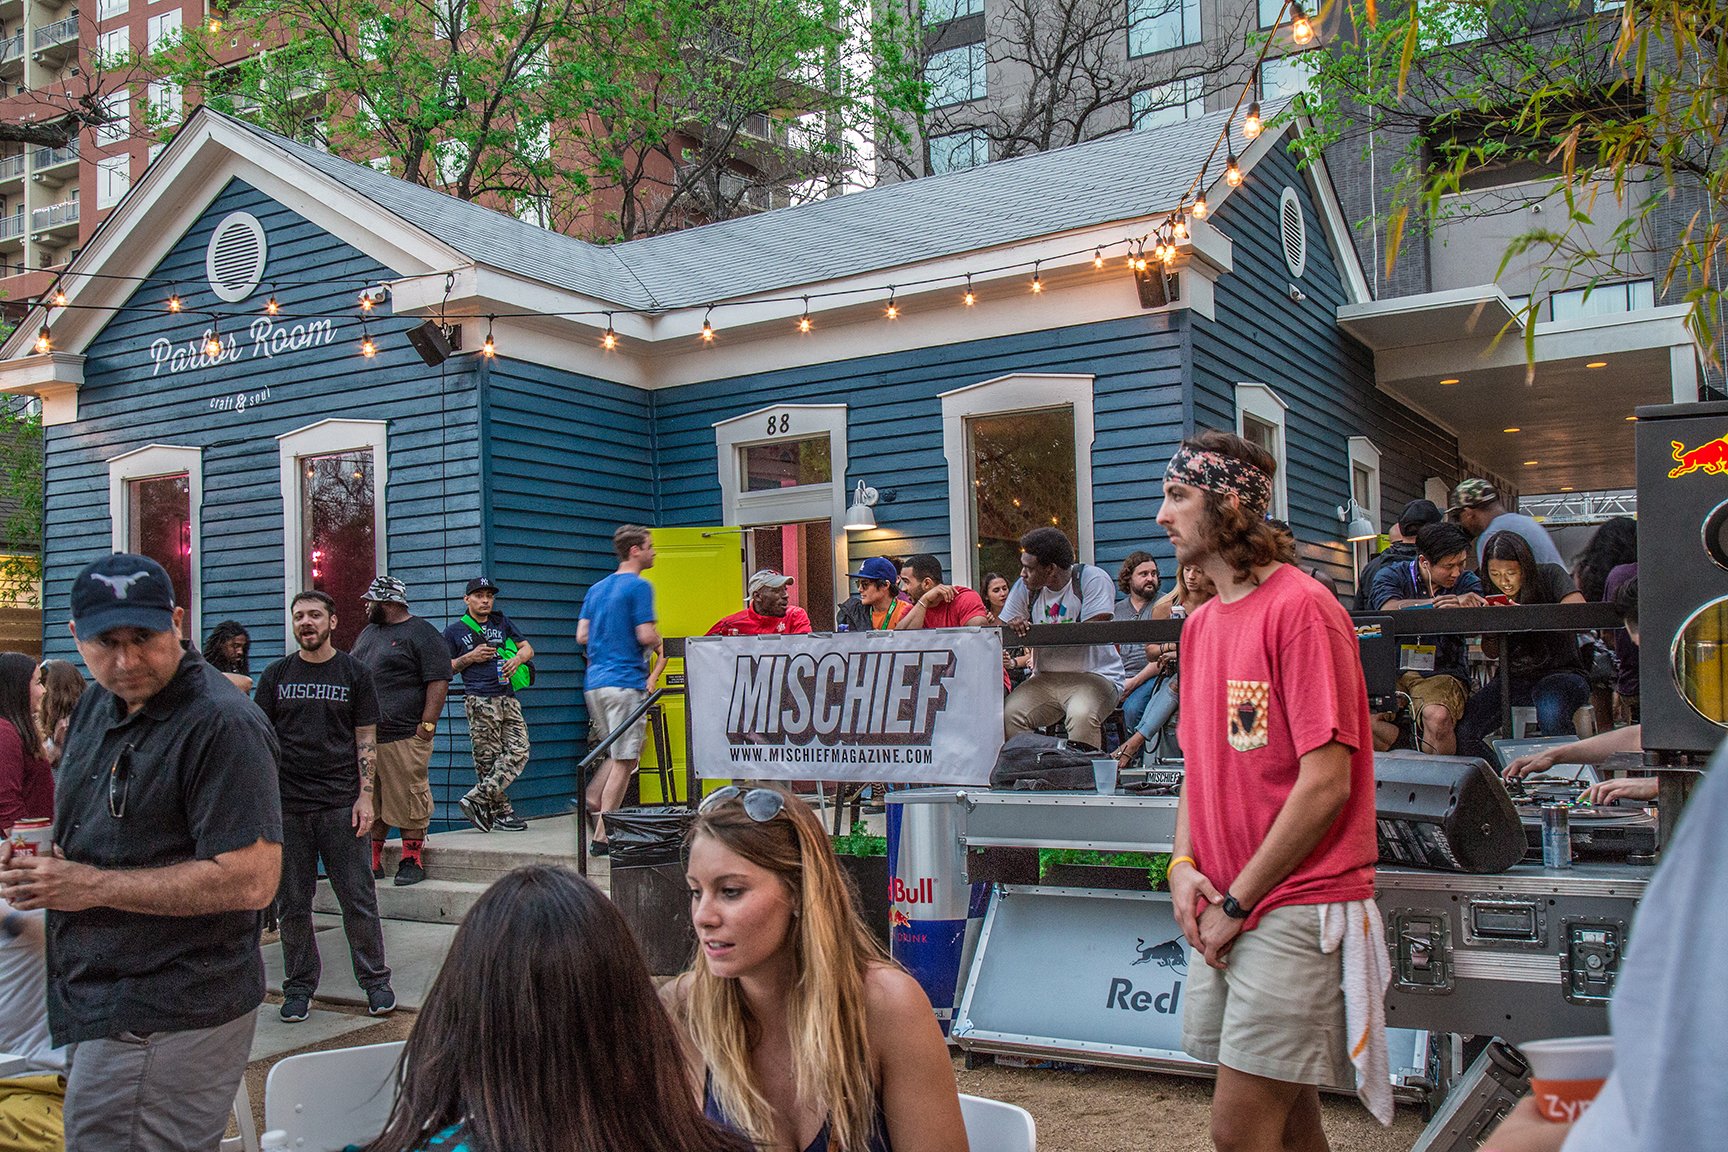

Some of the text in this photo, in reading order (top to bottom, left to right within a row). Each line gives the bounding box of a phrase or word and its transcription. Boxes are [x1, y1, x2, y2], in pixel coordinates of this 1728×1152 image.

[150, 316, 338, 376] Parlor Room
[209, 385, 271, 413] craft & soul
[766, 413, 790, 435] 88
[278, 683, 350, 702] MISCHIEF
[726, 649, 958, 746] MISCHIEF
[729, 747, 933, 764] WWW.MISCHIEFMAGAZINE.COM
[1147, 770, 1180, 784] MISCHIEF
[893, 877, 933, 904] Bull
[897, 932, 928, 943] DRINK
[1106, 977, 1182, 1014] Red
